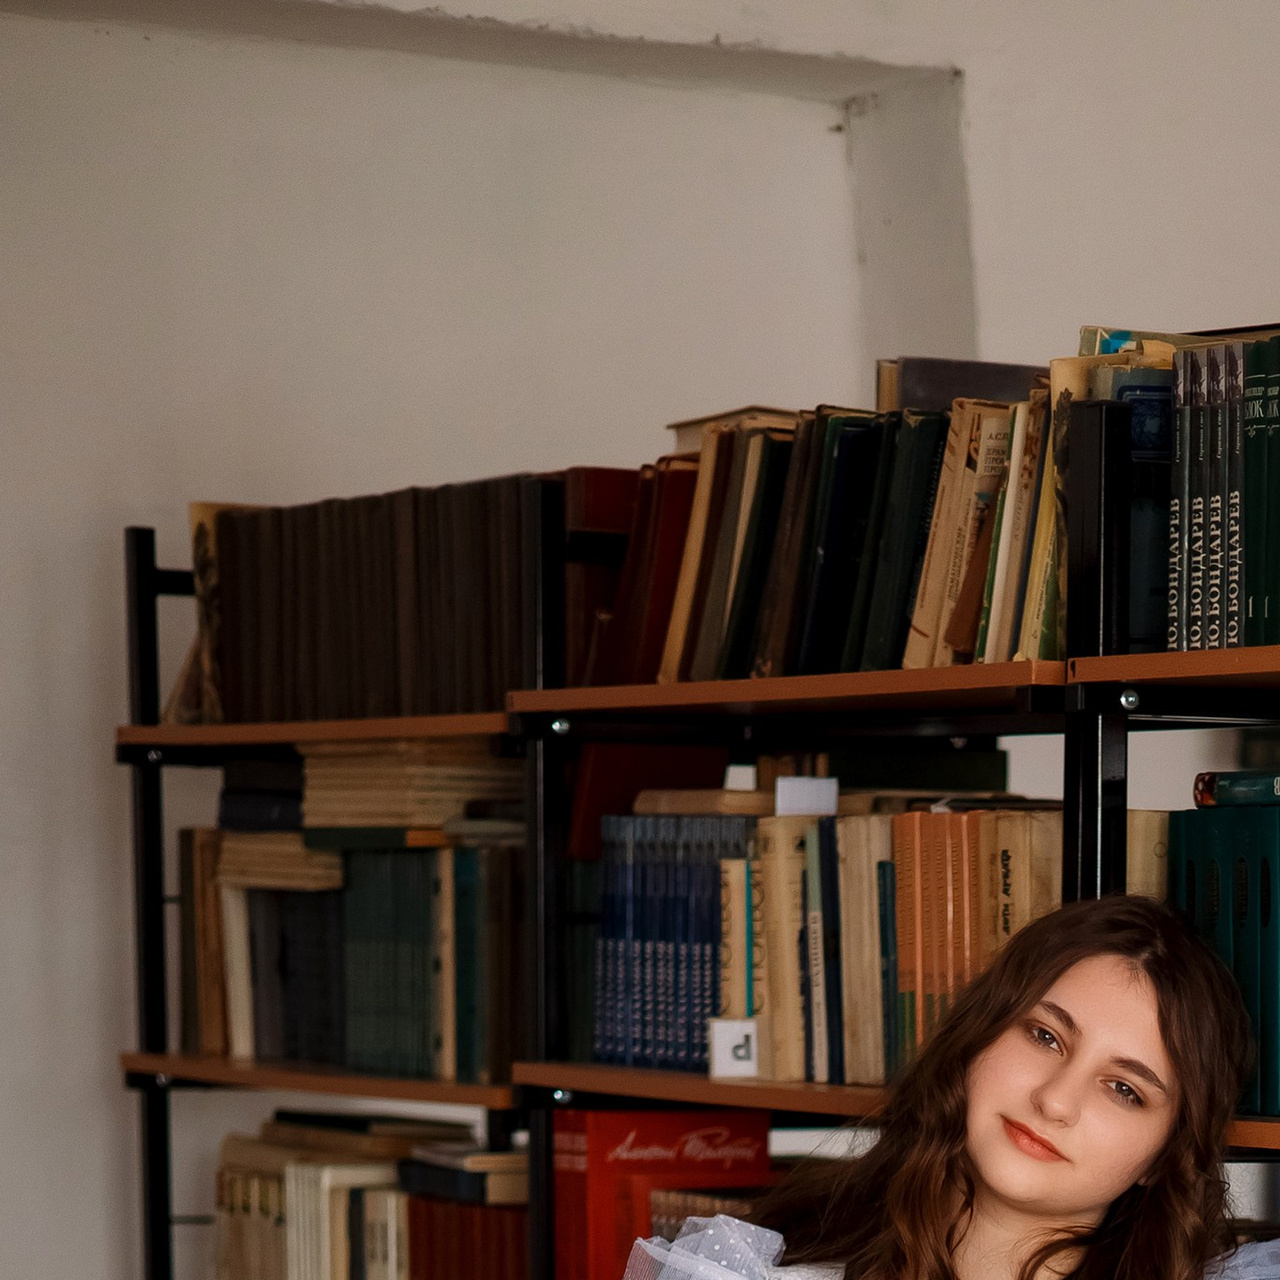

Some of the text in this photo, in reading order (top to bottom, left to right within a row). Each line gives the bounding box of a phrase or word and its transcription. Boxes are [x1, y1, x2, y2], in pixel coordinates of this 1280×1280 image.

[1167, 499, 1182, 649] Ю. БОНДАРЕВ
[1190, 496, 1206, 650] Ю. БОНДАРЕВ
[1207, 495, 1223, 649] Ю. БОНДАРЕВ
[1227, 491, 1243, 644] Ю. БОНДАРЕВ
